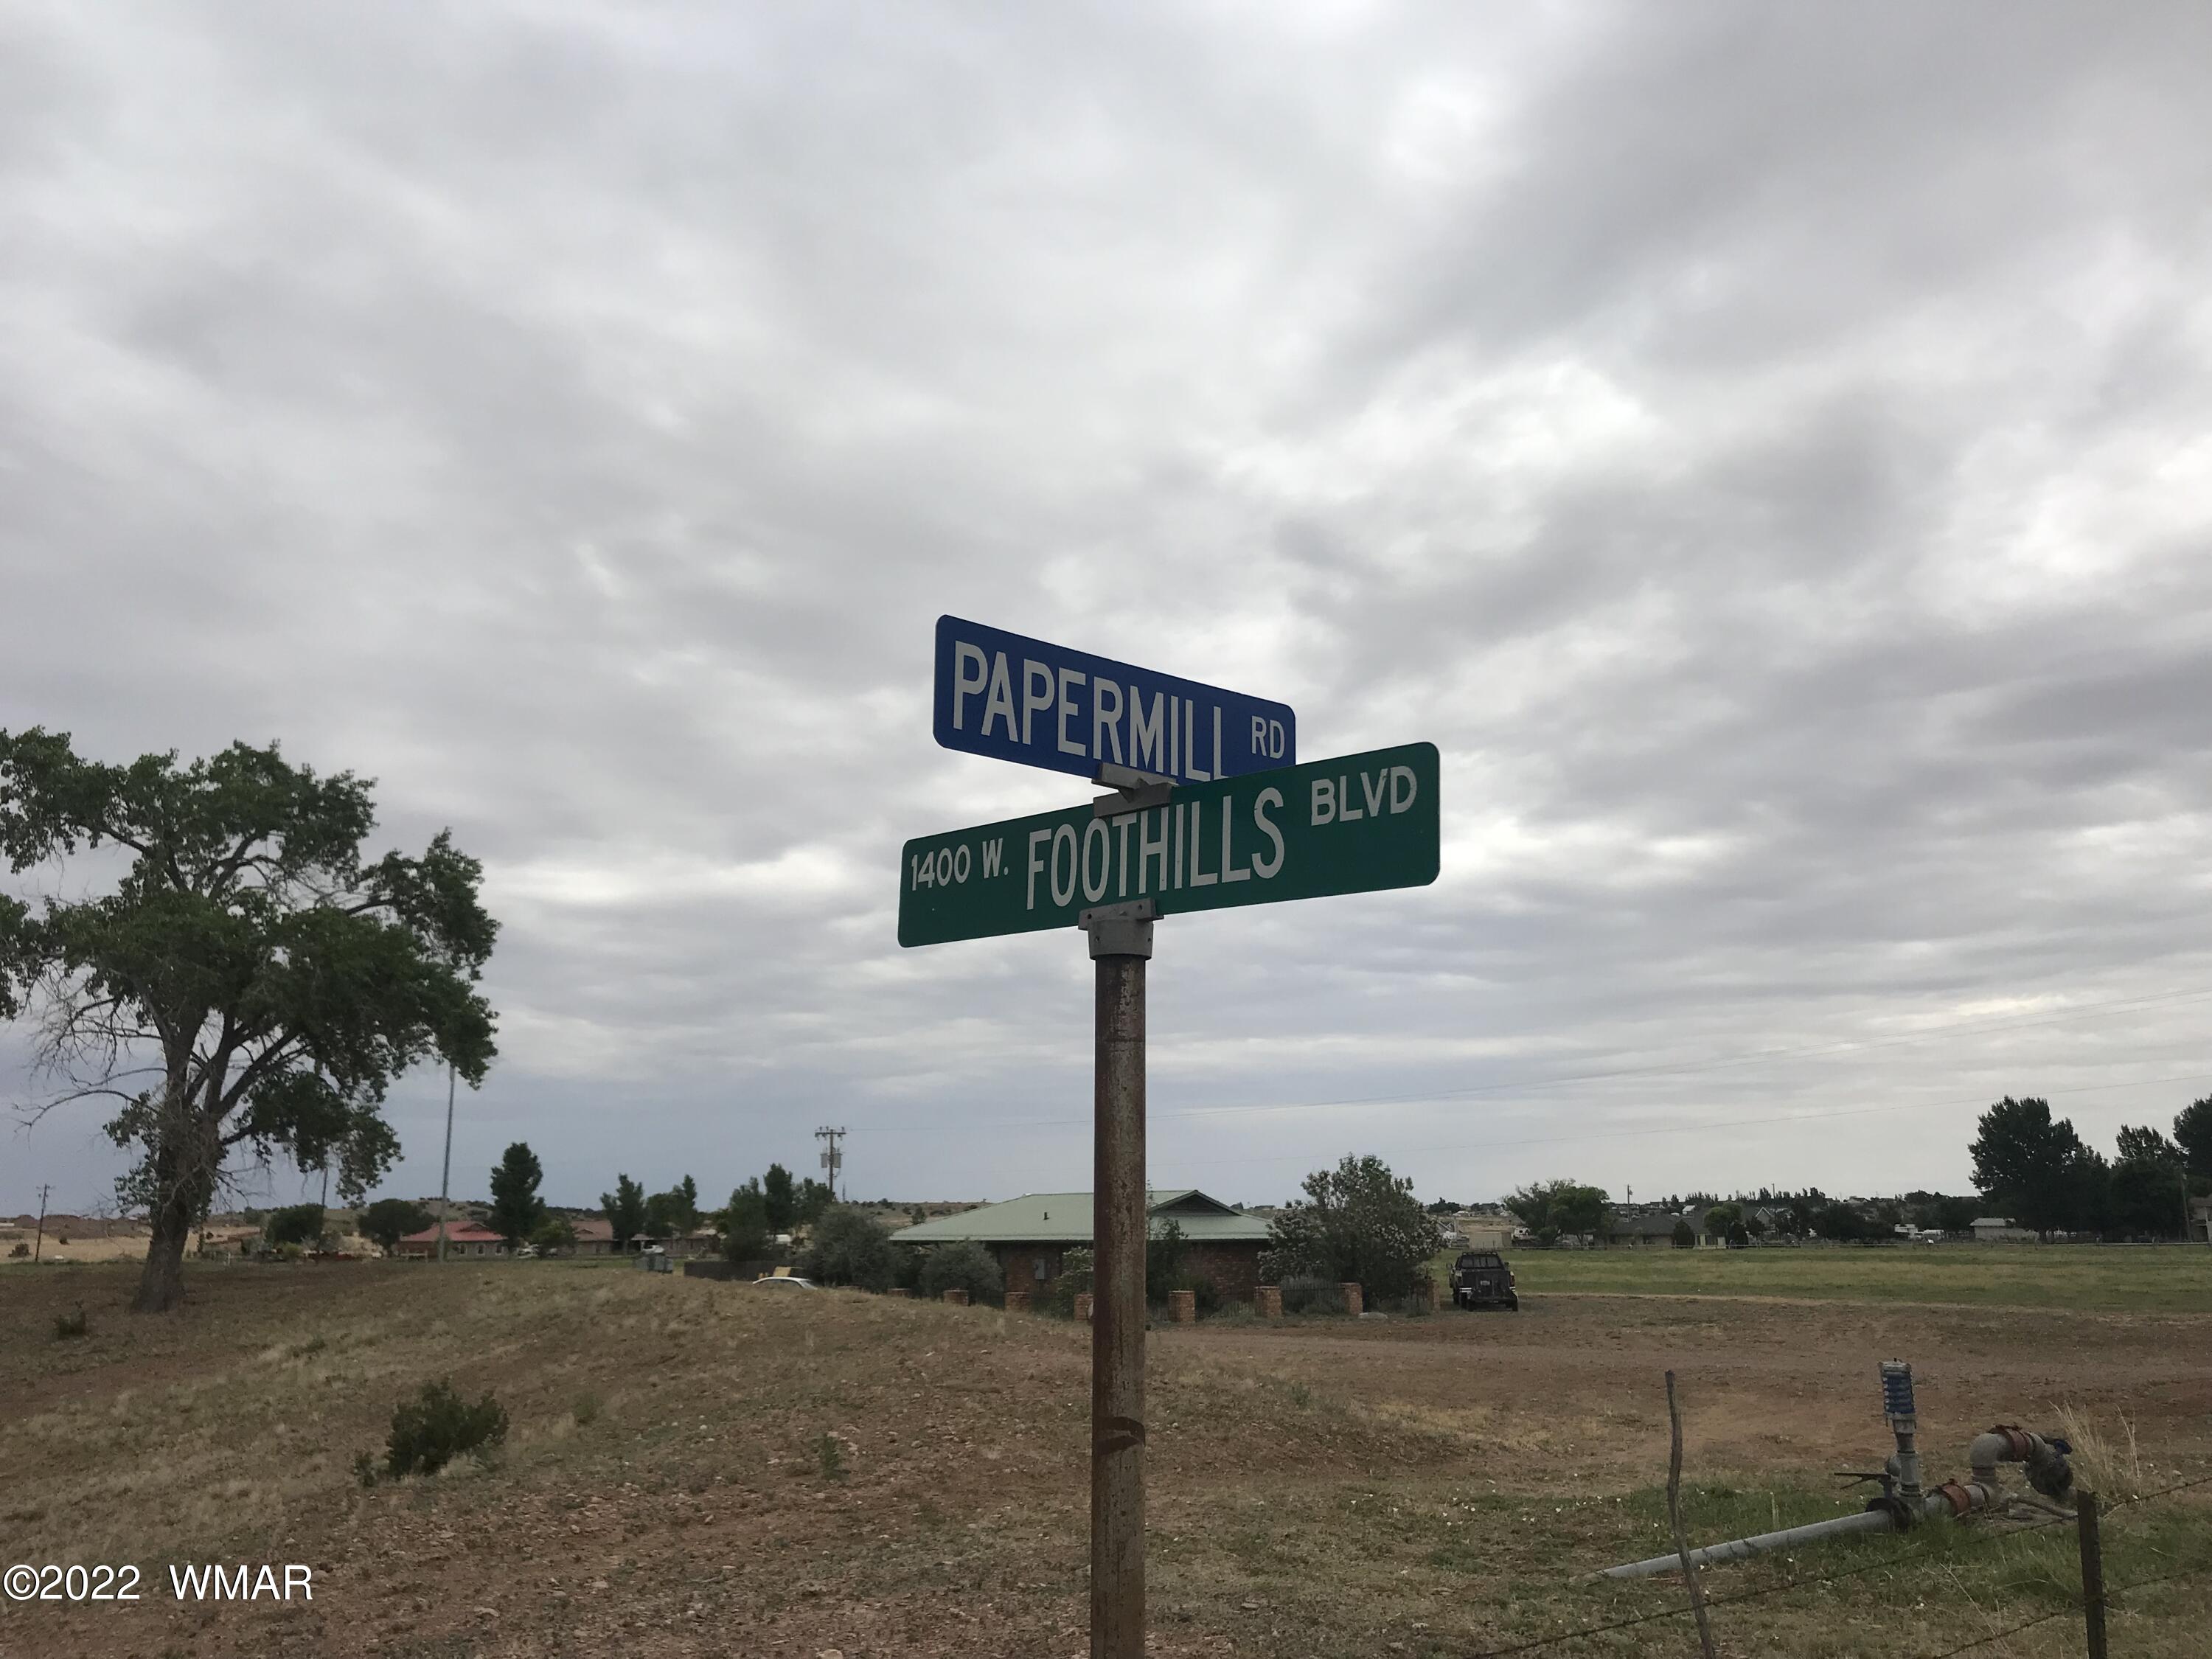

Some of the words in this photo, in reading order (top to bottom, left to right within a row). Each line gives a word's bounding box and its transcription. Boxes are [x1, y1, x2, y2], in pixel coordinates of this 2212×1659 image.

[953, 640, 1231, 782] PAPERMILL
[1251, 715, 1285, 760] RD
[911, 844, 971, 891] 1400
[982, 838, 1009, 880] W.
[1026, 787, 1284, 911] FOOTHILLS
[1310, 765, 1418, 827] BLVD
